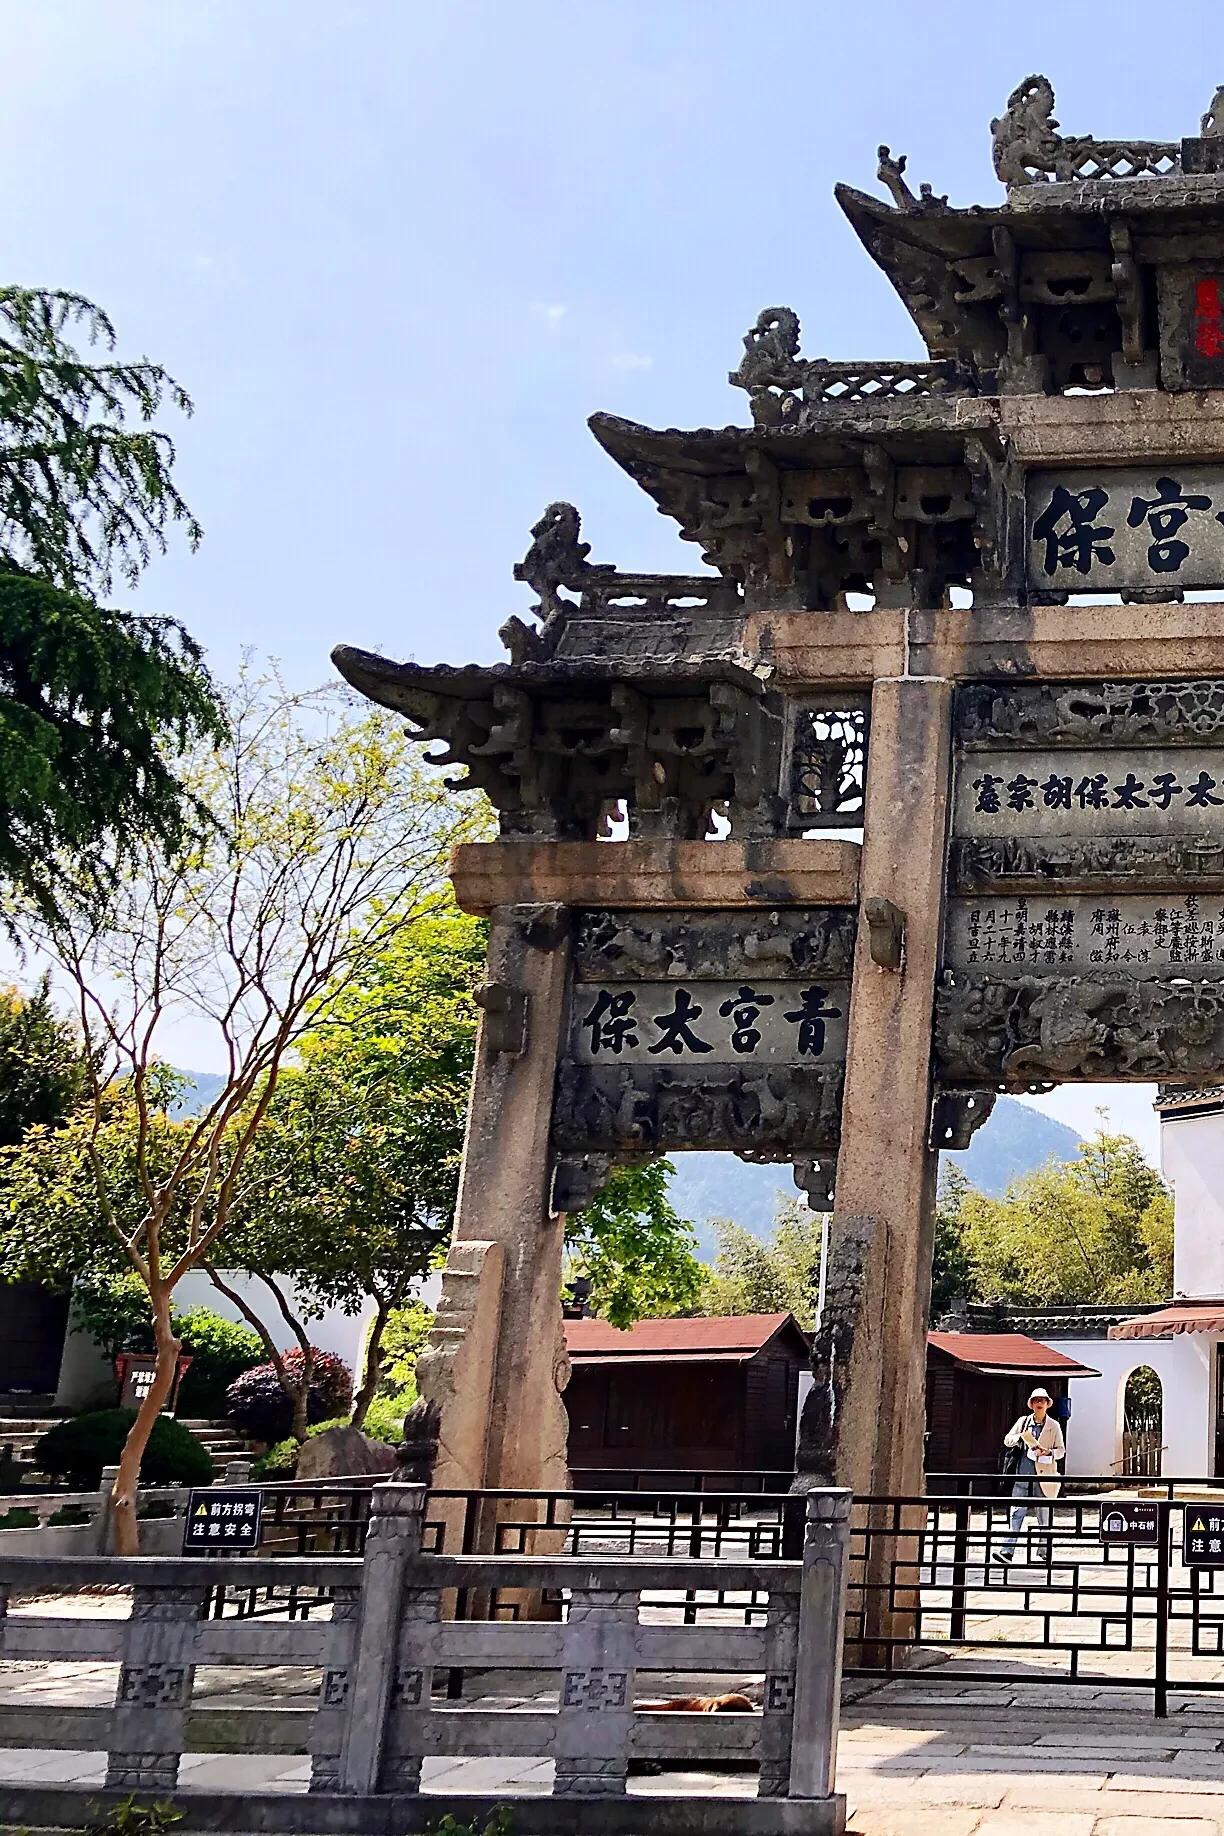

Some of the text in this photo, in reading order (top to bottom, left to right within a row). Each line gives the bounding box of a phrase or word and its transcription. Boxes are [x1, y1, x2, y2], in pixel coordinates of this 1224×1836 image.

[210, 1502, 255, 1517] 前方拐弯
[192, 1523, 253, 1536] 注意安全
[1130, 1520, 1155, 1530] 中石桥
